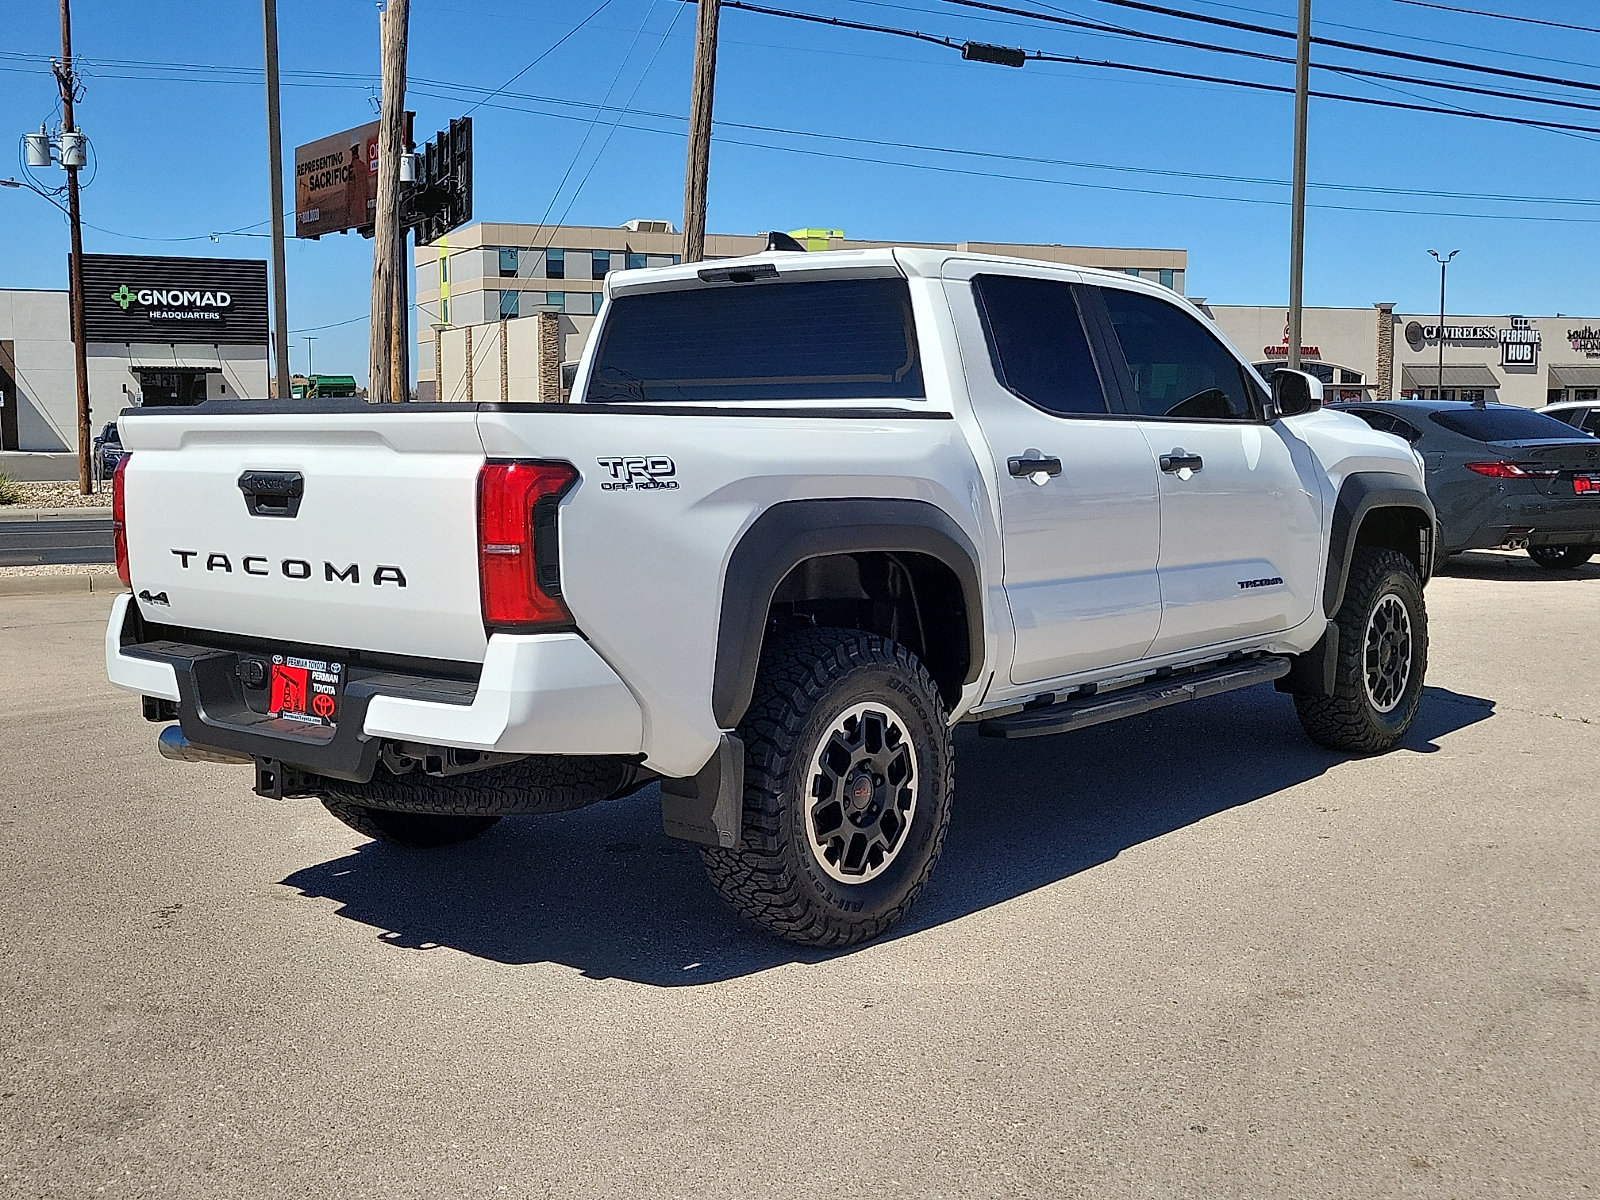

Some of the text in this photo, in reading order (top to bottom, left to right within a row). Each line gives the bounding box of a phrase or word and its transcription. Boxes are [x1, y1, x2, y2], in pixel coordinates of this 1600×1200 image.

[297, 151, 344, 177] REPRESENTING
[309, 163, 356, 192] SACRIFICE
[137, 290, 231, 307] GNOMAD
[149, 310, 220, 320] HEADQUARTERS
[1423, 326, 1497, 339] CJ WIRELESS
[1500, 330, 1540, 343] PERFUME
[1566, 325, 1600, 342] southe
[1263, 346, 1320, 355] CARNERIA
[1508, 344, 1532, 361] HUB
[1579, 340, 1600, 352] HON
[597, 456, 676, 482] TRD
[601, 481, 680, 491] OFF ROAD
[170, 549, 407, 588] TACOMA
[1237, 577, 1284, 589] TACOMA
[287, 657, 327, 670] PERMIAN TOYOTA
[312, 671, 338, 683] PERMIAN
[313, 683, 336, 695] TOYOTA
